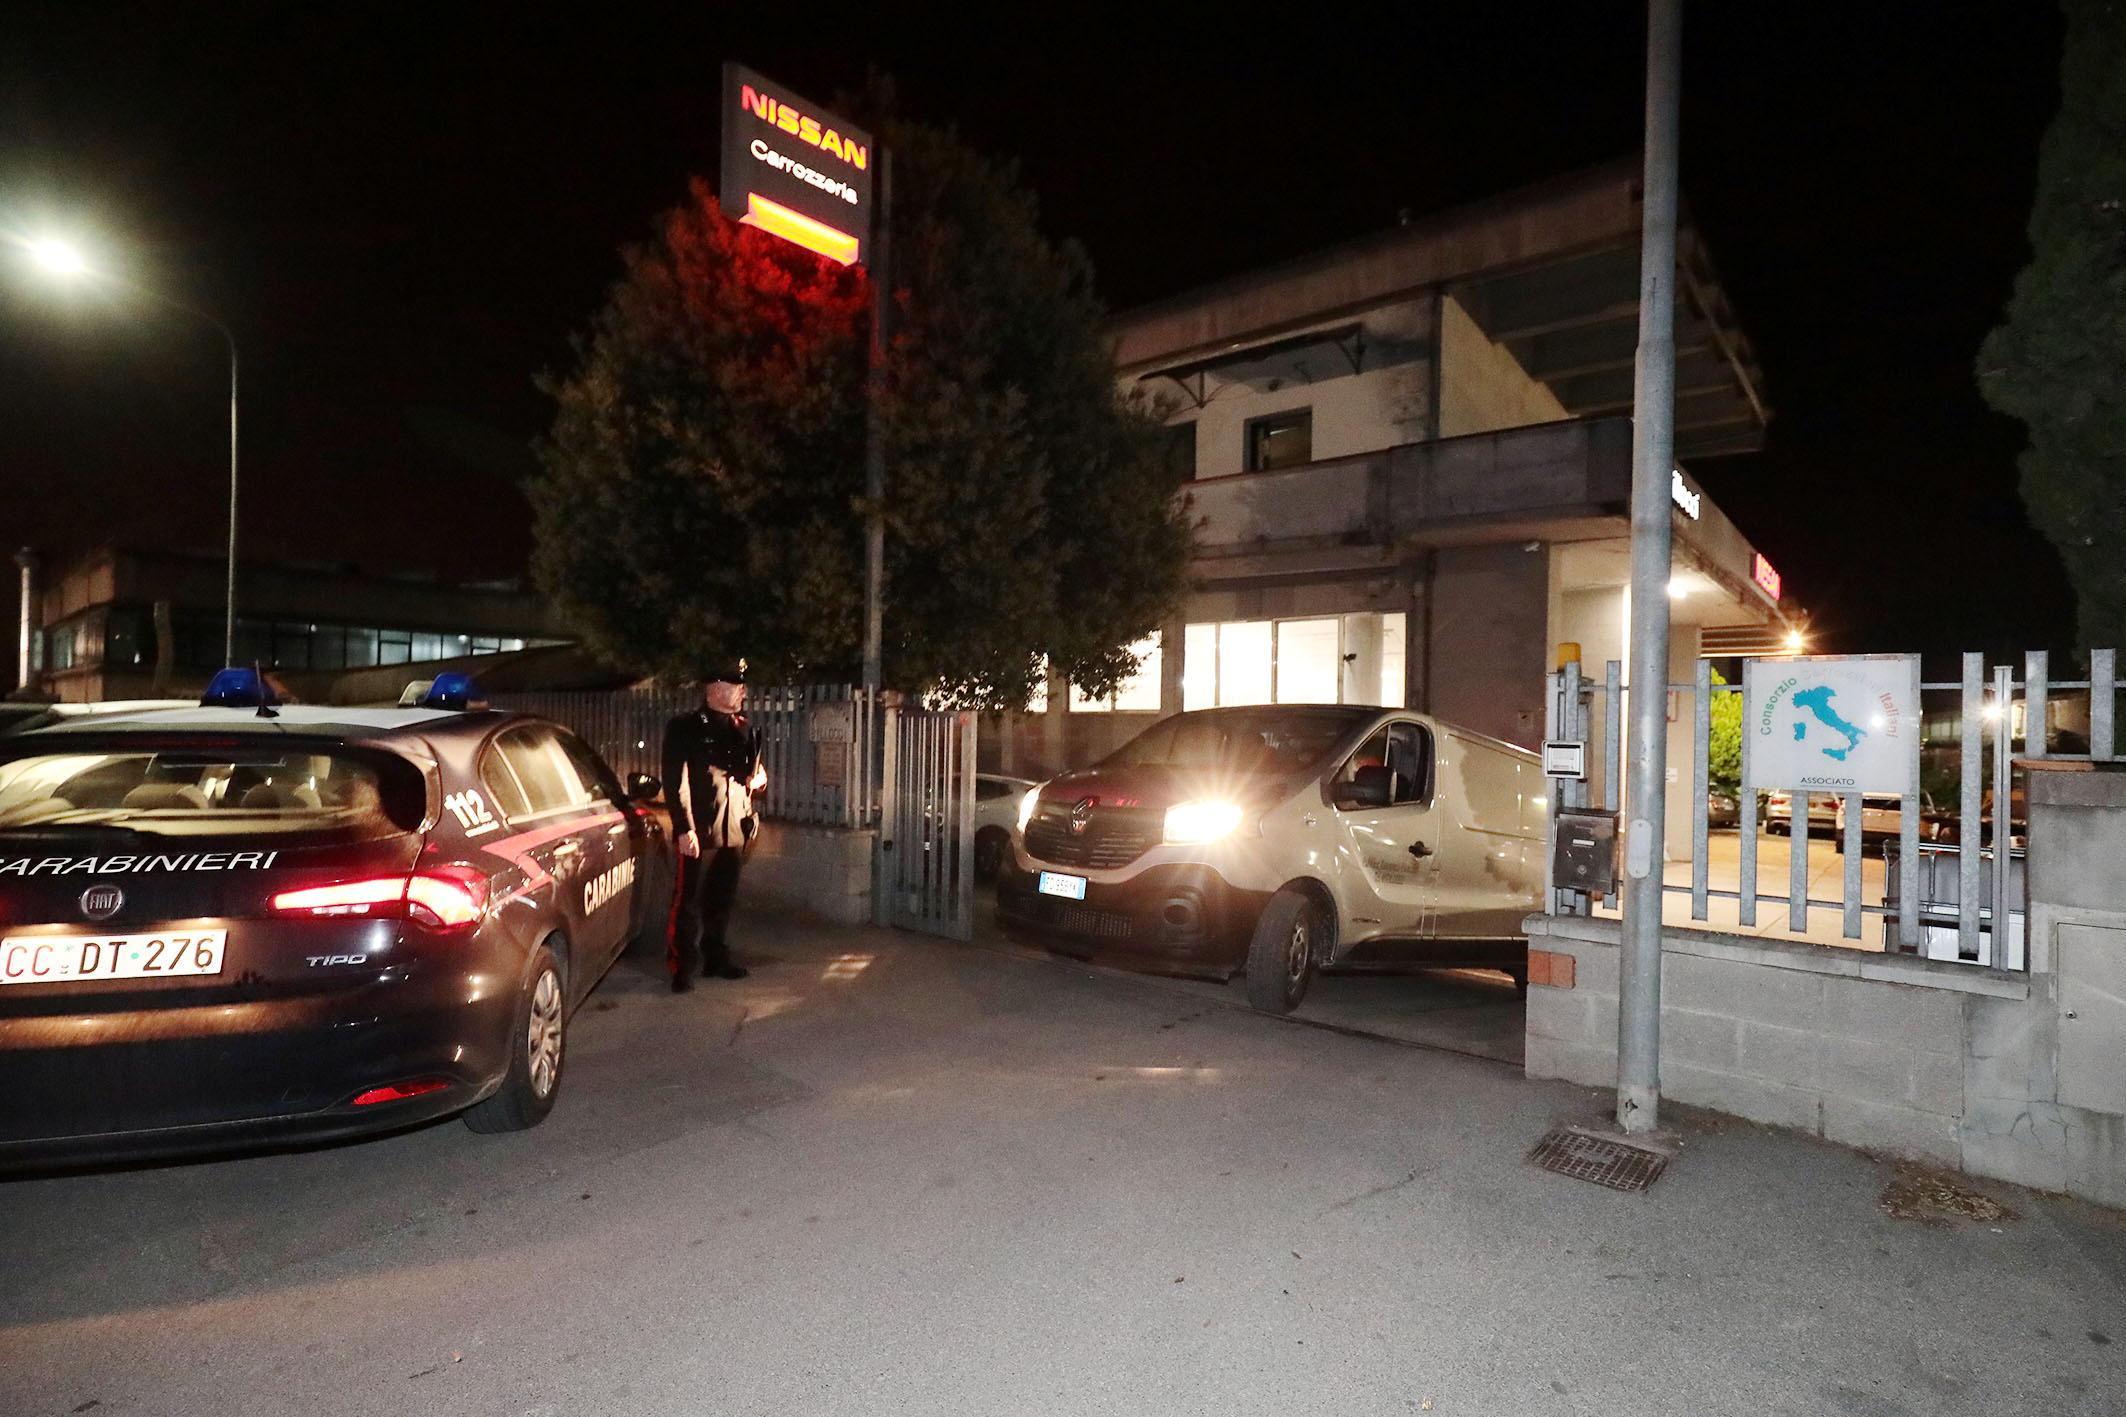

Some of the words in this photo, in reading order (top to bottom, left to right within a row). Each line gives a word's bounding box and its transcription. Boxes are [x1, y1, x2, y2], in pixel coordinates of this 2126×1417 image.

[741, 84, 866, 170] NISSAN
[750, 139, 858, 205] Carrozzeria
[1760, 677, 1797, 736] Consorzio
[1800, 777, 1855, 786] ASSOCIATO
[444, 789, 493, 828] 112
[89, 893, 116, 909] FIAT
[5, 945, 53, 977] CC
[79, 942, 127, 974] DT
[143, 938, 214, 971] 276
[306, 954, 366, 967] TIPO
